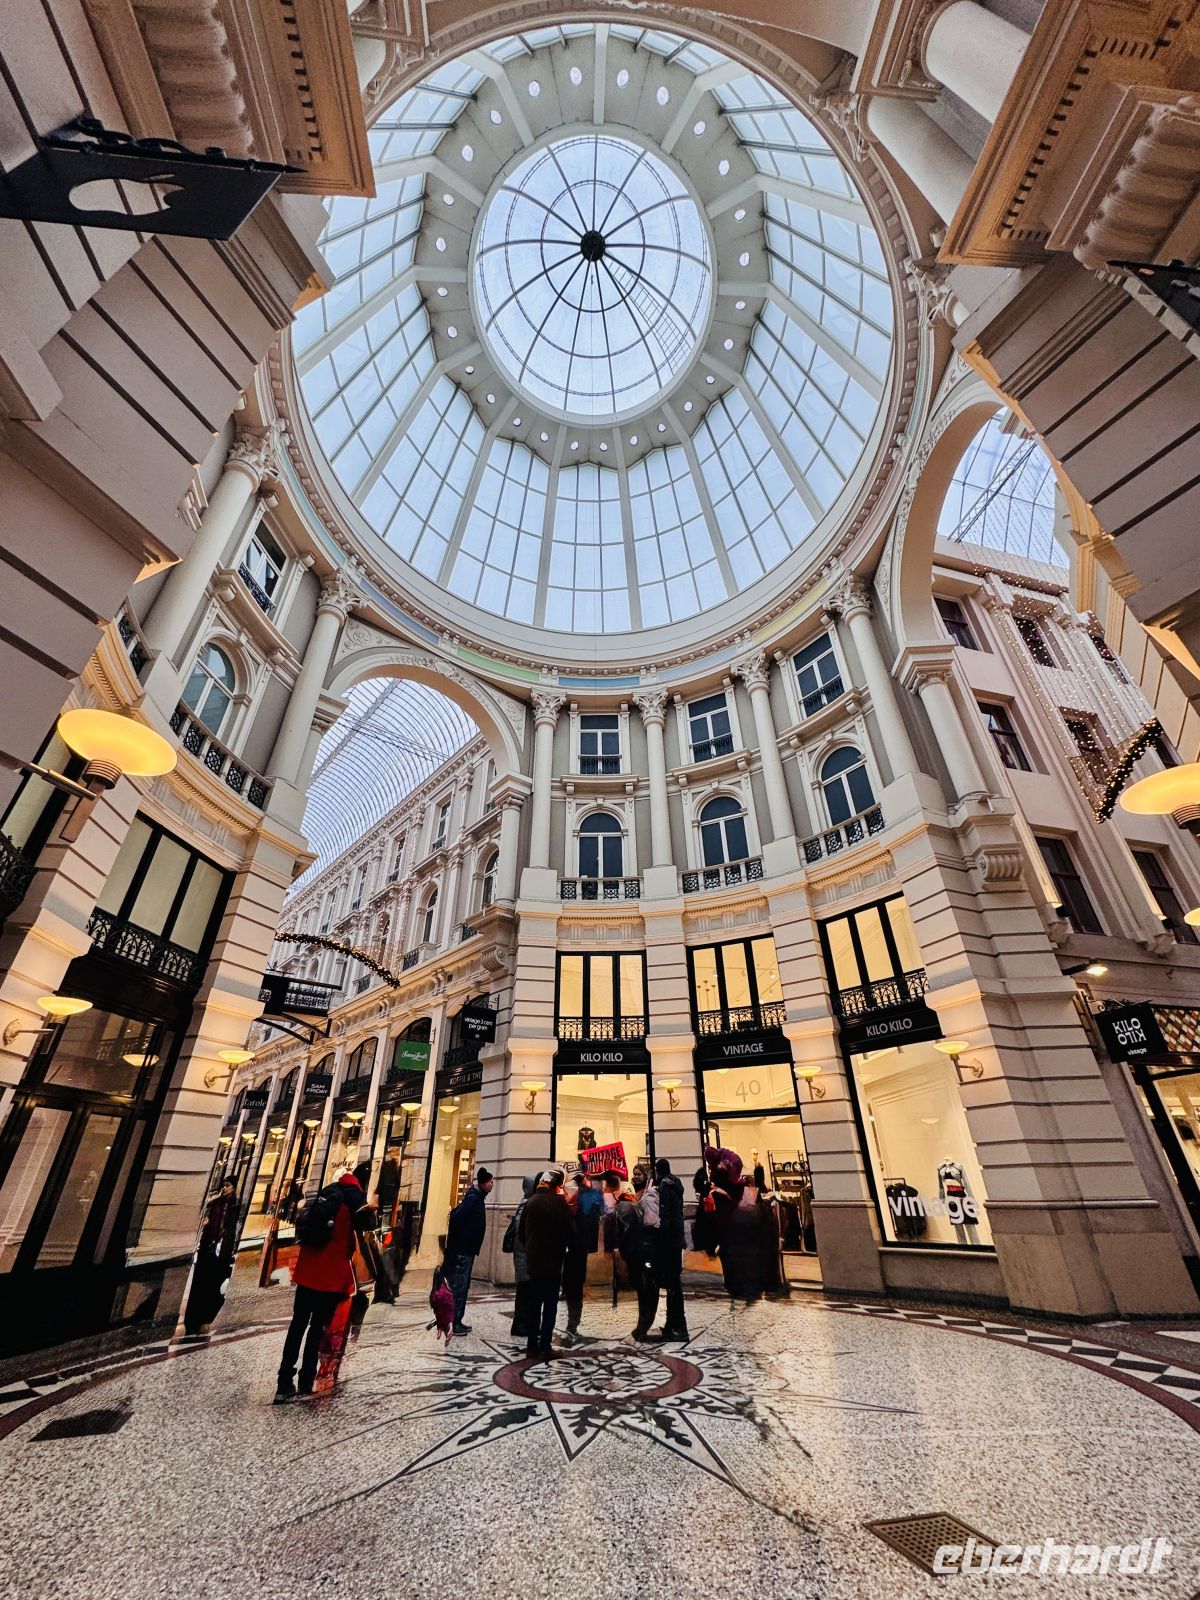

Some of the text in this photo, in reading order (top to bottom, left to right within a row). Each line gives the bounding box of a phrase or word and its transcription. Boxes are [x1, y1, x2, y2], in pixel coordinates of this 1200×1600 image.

[866, 1018, 912, 1037] KILO KILO
[1112, 1017, 1141, 1034] KILO
[580, 1052, 623, 1062] KILO KILO
[722, 1042, 764, 1056] VINTAGE
[735, 1079, 761, 1103] 40
[887, 1190, 980, 1225] vintage
